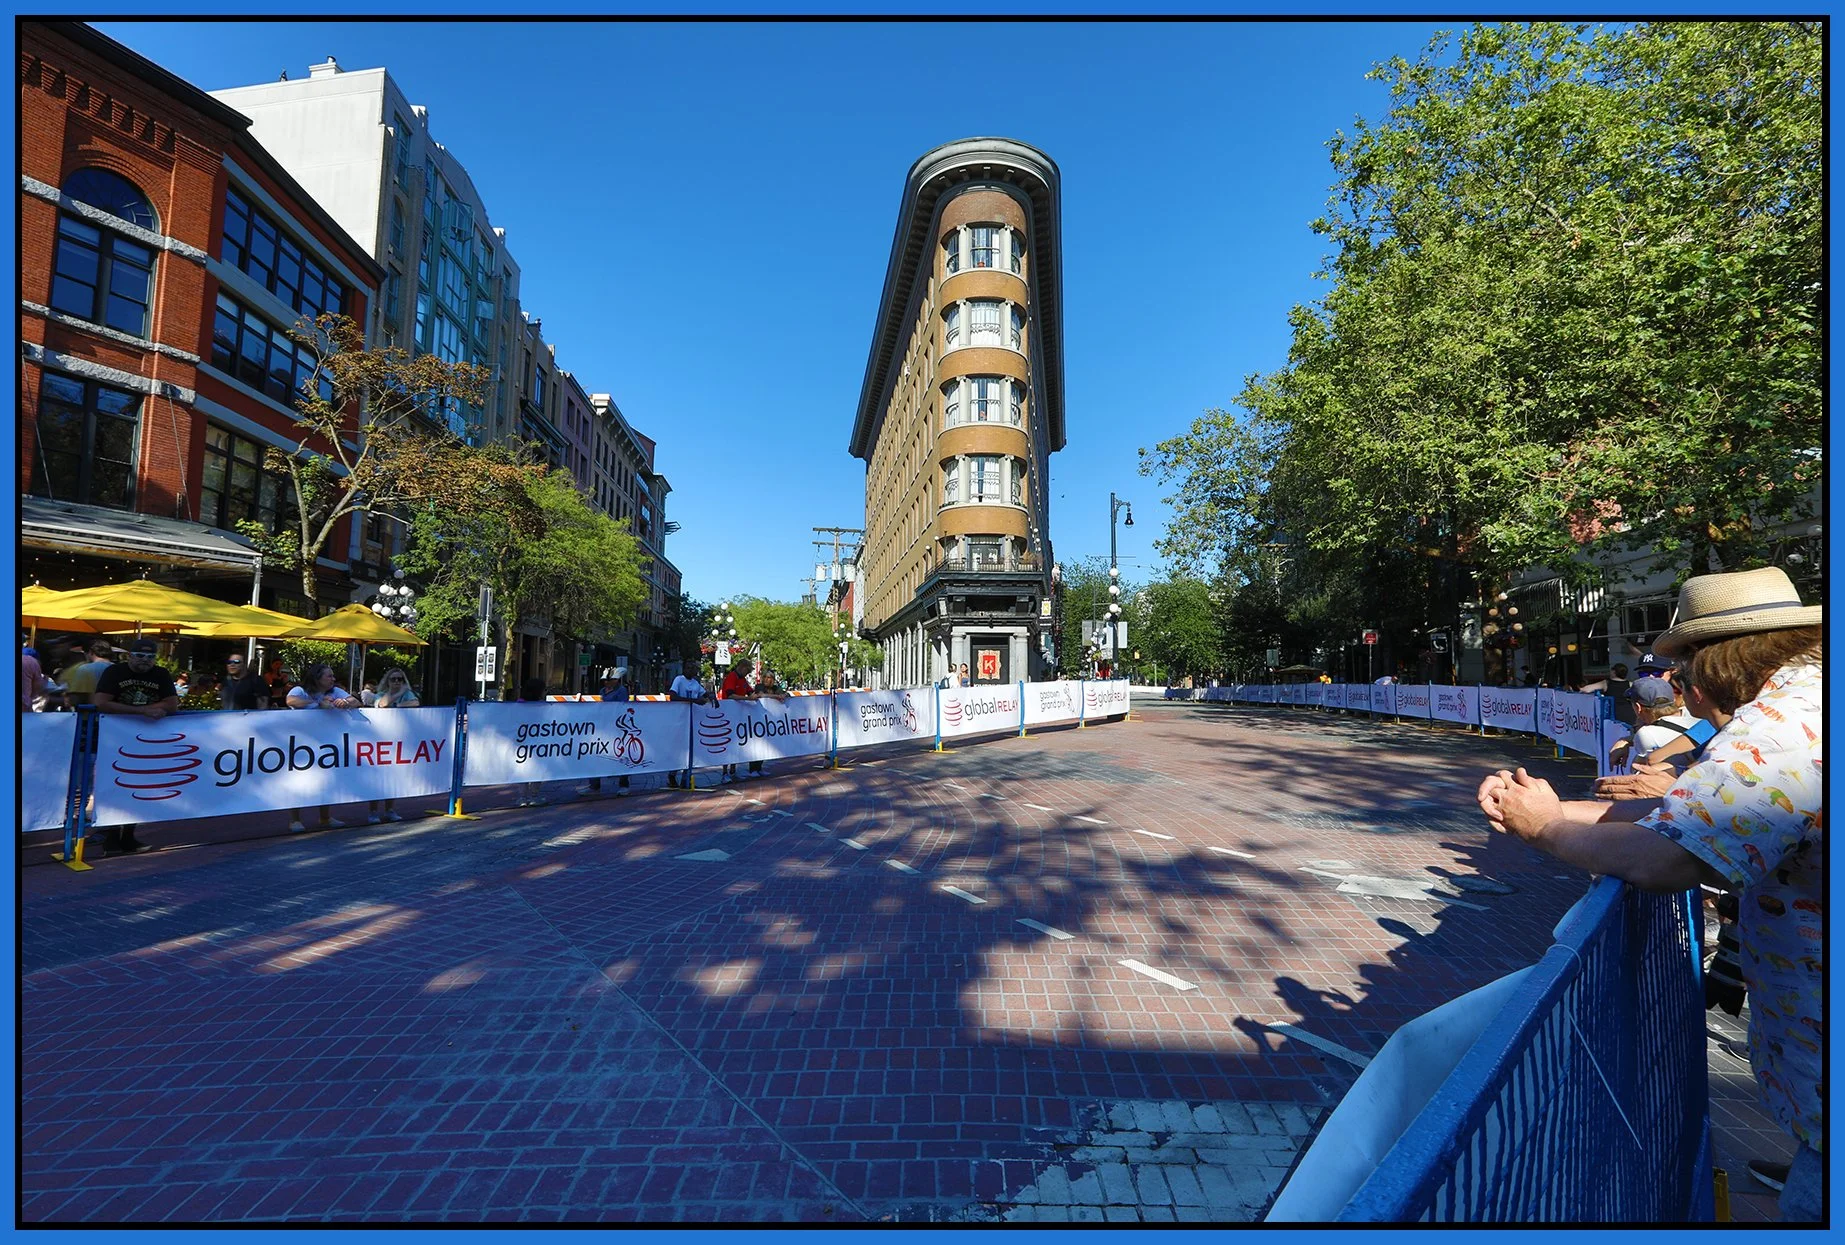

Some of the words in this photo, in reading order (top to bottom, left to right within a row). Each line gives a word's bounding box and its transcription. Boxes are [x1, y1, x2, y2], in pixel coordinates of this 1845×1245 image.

[984, 660, 994, 671] K
[860, 702, 895, 718] gastown
[517, 719, 596, 743] gastown
[863, 714, 887, 732] grand
[889, 713, 902, 729] prix
[515, 738, 573, 763] grand
[577, 738, 610, 760] prix
